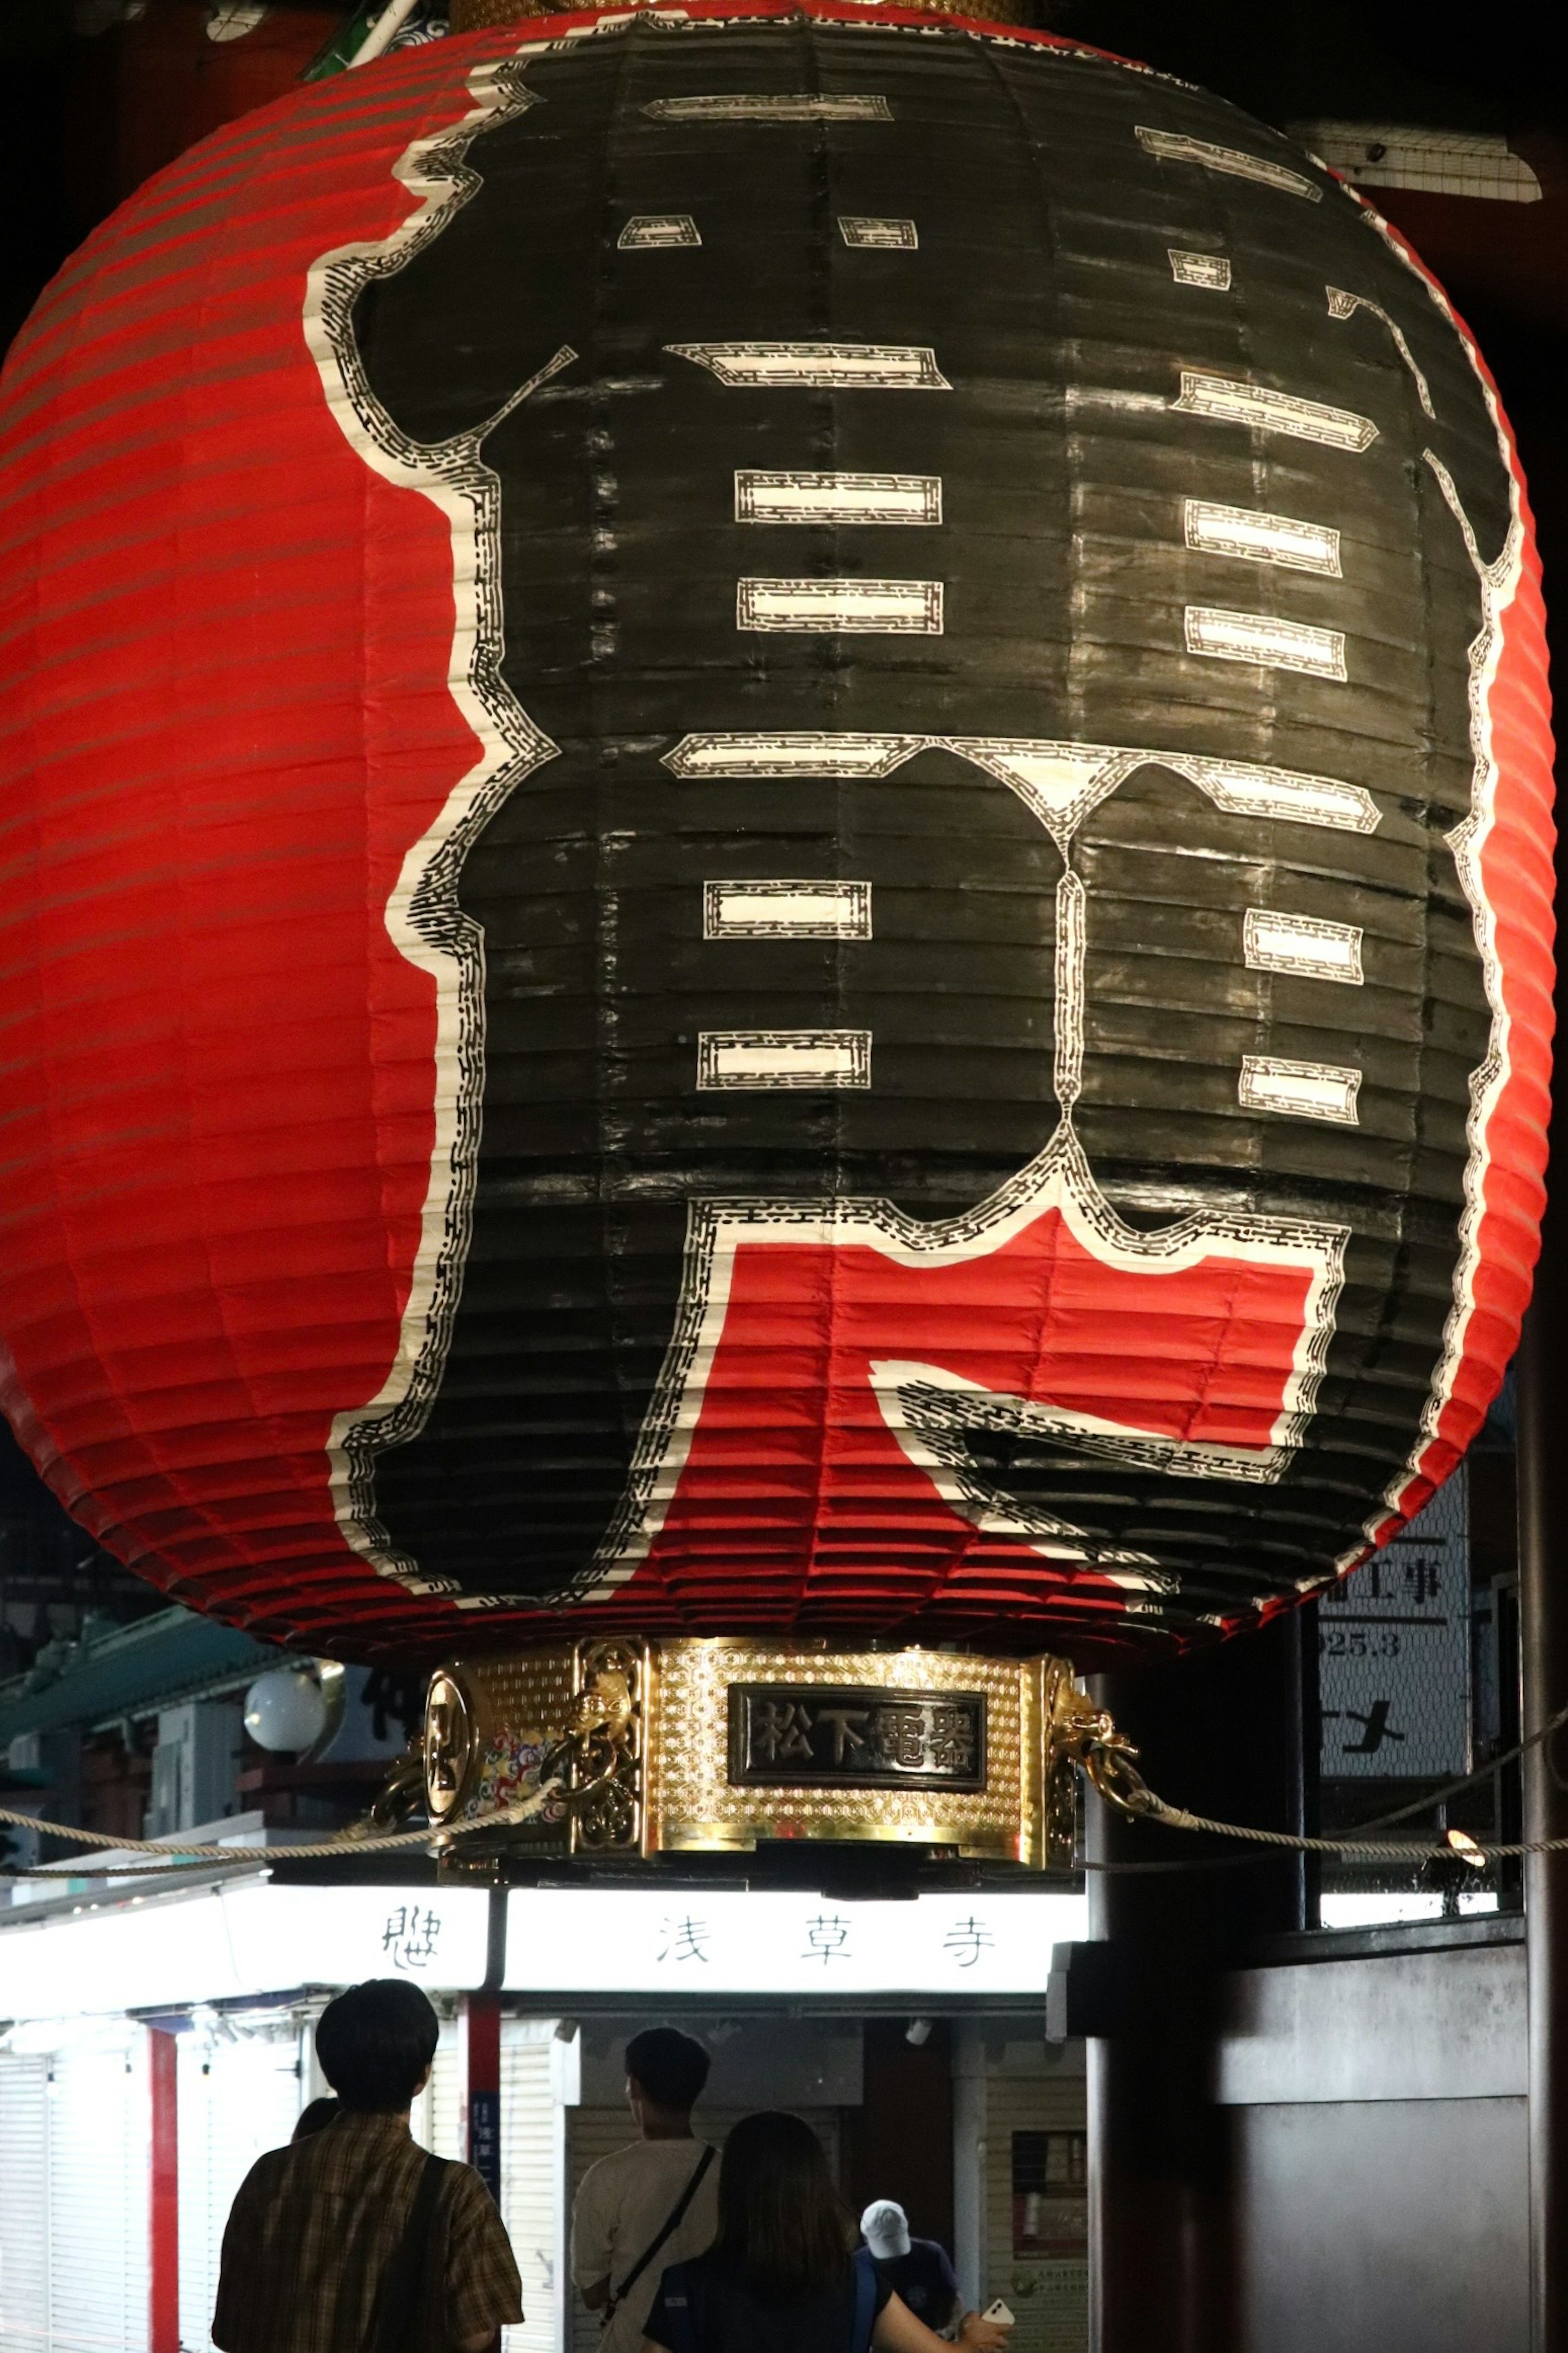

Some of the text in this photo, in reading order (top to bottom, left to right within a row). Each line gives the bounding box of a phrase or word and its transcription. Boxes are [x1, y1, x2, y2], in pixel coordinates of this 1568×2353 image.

[751, 1701, 975, 1769] 松下電器
[656, 1914, 996, 1968] 浅草寺
